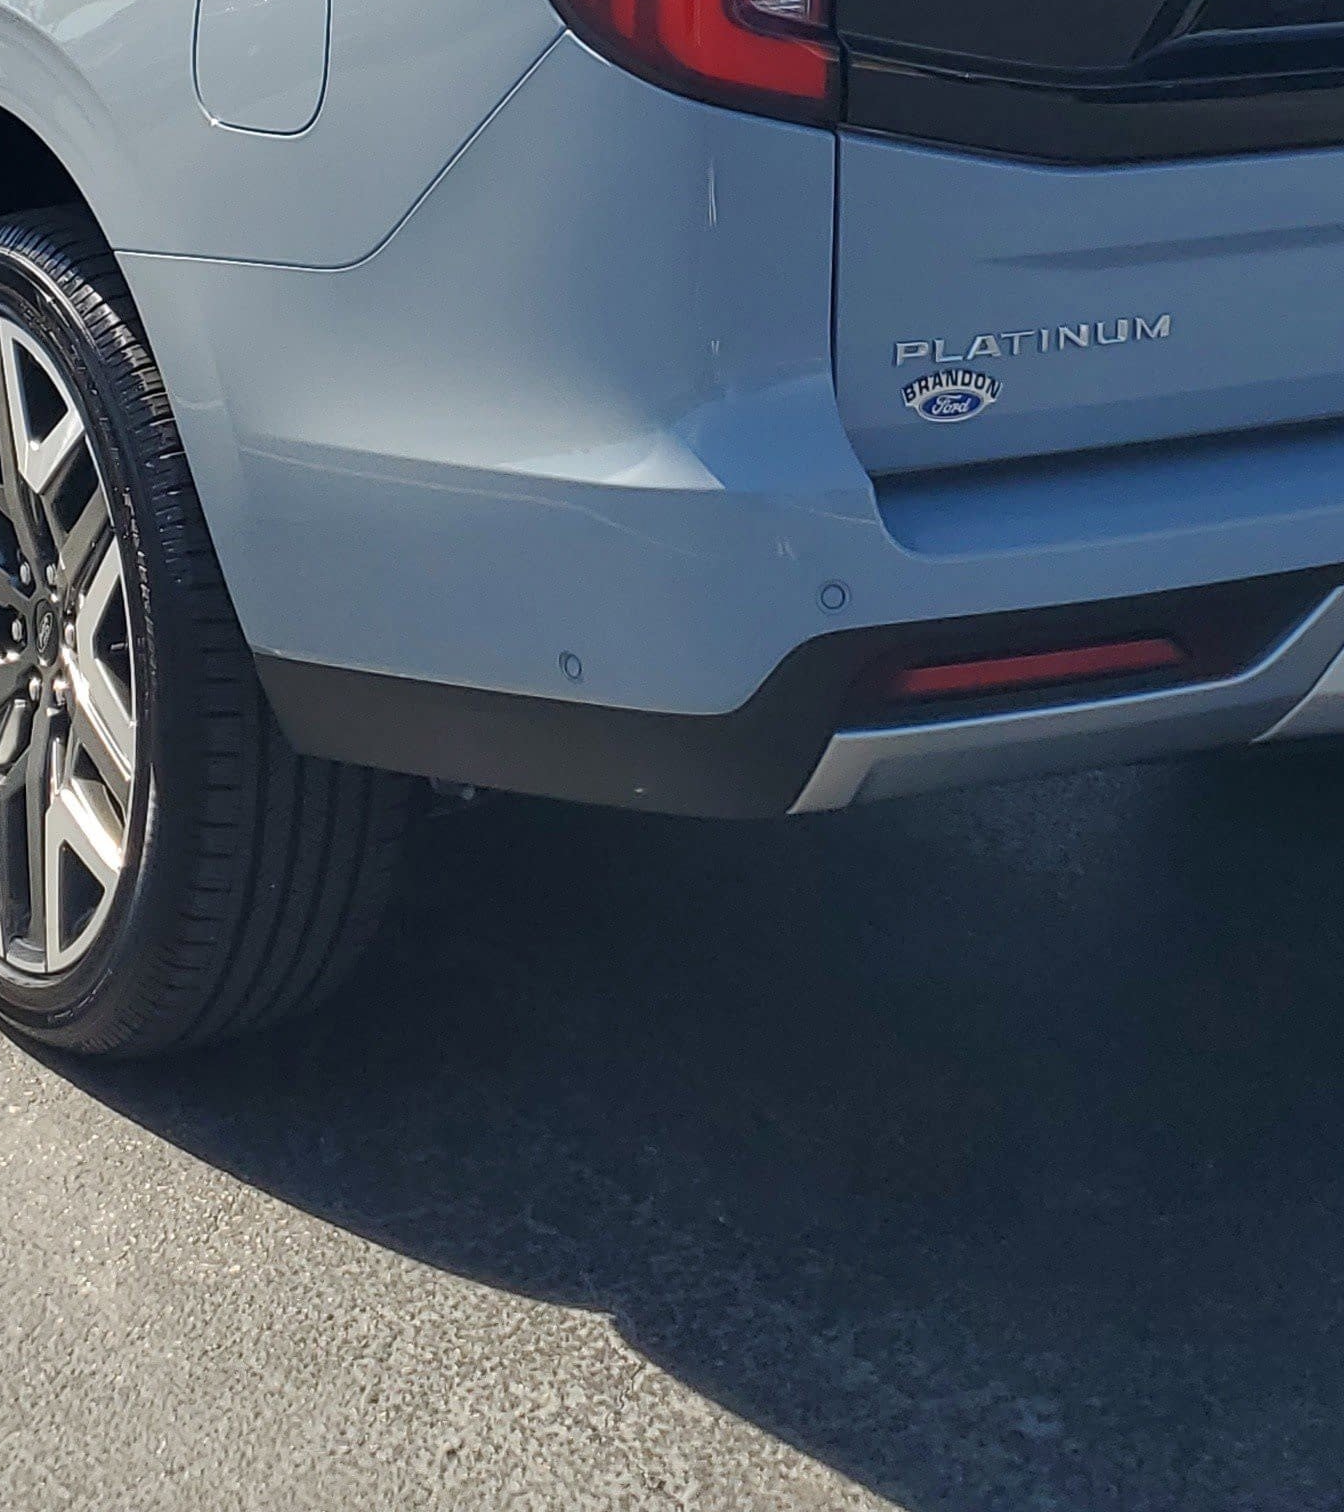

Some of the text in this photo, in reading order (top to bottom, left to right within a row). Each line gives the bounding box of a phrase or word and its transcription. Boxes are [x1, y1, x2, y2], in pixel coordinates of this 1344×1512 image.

[892, 314, 1171, 367] PLATINUM
[904, 368, 1002, 404] BRANDON
[932, 393, 970, 416] Ford
